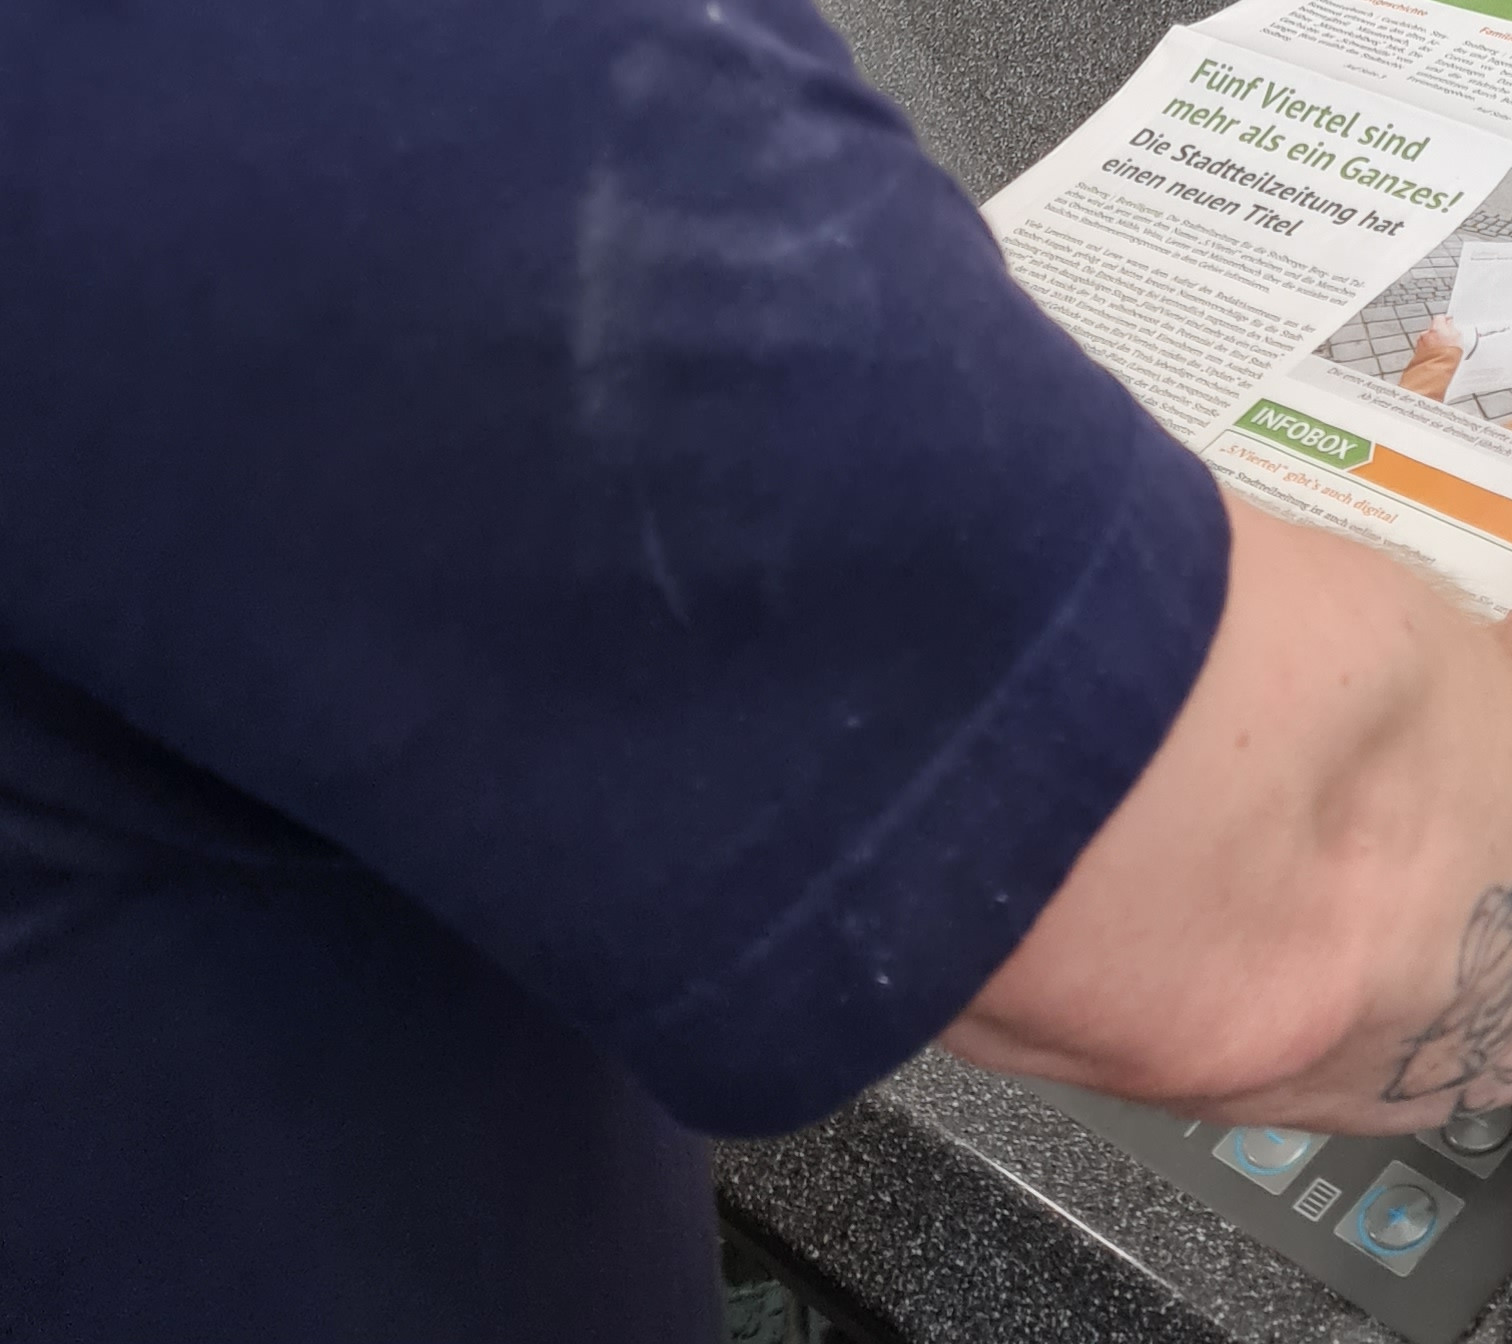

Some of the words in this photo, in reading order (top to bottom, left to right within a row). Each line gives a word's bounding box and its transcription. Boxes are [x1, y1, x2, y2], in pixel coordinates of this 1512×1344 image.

[1162, 96, 1241, 135] mehr
[1239, 124, 1286, 153] als
[1286, 142, 1337, 171] ein
[1340, 156, 1464, 214] Ganzes!
[1189, 58, 1264, 102] Fünf
[1261, 81, 1361, 139] Viertel
[1358, 123, 1431, 163] sind
[1101, 158, 1166, 190] einen
[1166, 178, 1241, 216] neuen
[1243, 204, 1305, 237] Titel
[1128, 128, 1171, 155] Die
[1171, 143, 1358, 225] Stadtteilzeitung
[1358, 210, 1406, 237] hat
[1250, 407, 1358, 460] INFOBOX
[1320, 484, 1353, 505] auch
[1353, 500, 1399, 524] digital
